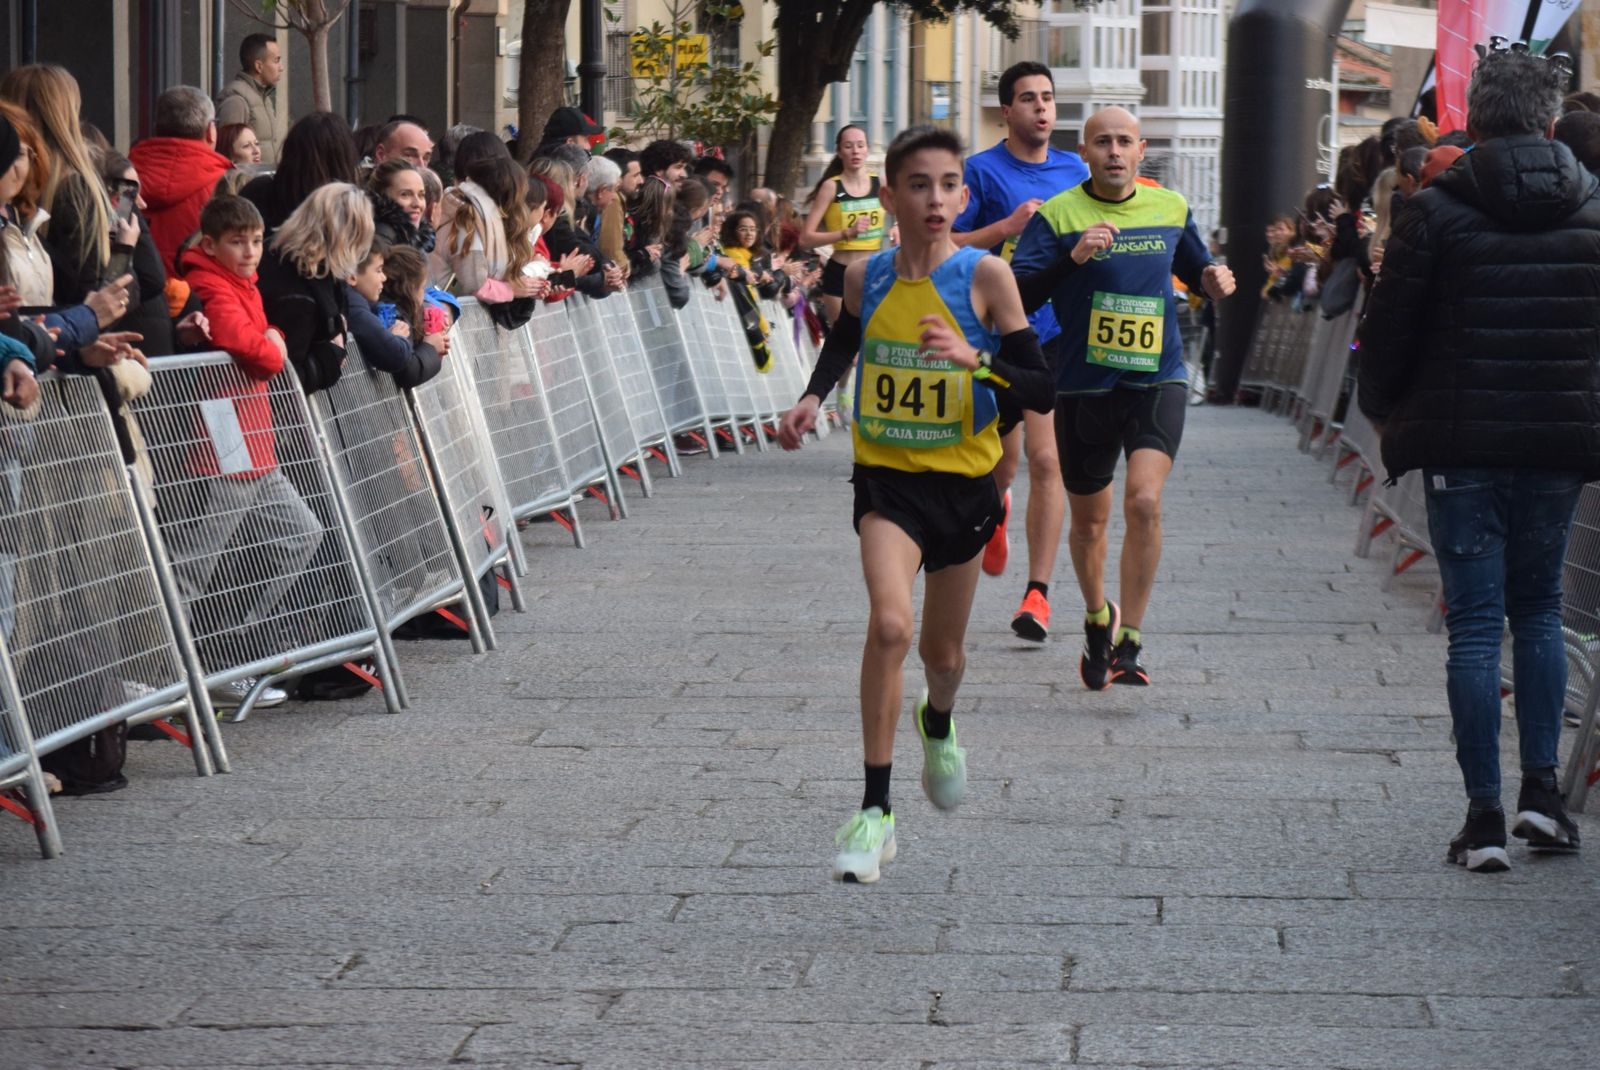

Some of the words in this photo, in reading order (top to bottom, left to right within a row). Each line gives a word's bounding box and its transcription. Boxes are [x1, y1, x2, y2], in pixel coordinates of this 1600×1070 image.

[1097, 316, 1154, 349] 556
[890, 356, 914, 368] CAJA
[1107, 353, 1128, 364] CAJA
[1130, 356, 1156, 366] RURAL
[876, 373, 946, 418] 941
[886, 427, 913, 439] CAJA
[915, 428, 956, 440] RURAL
